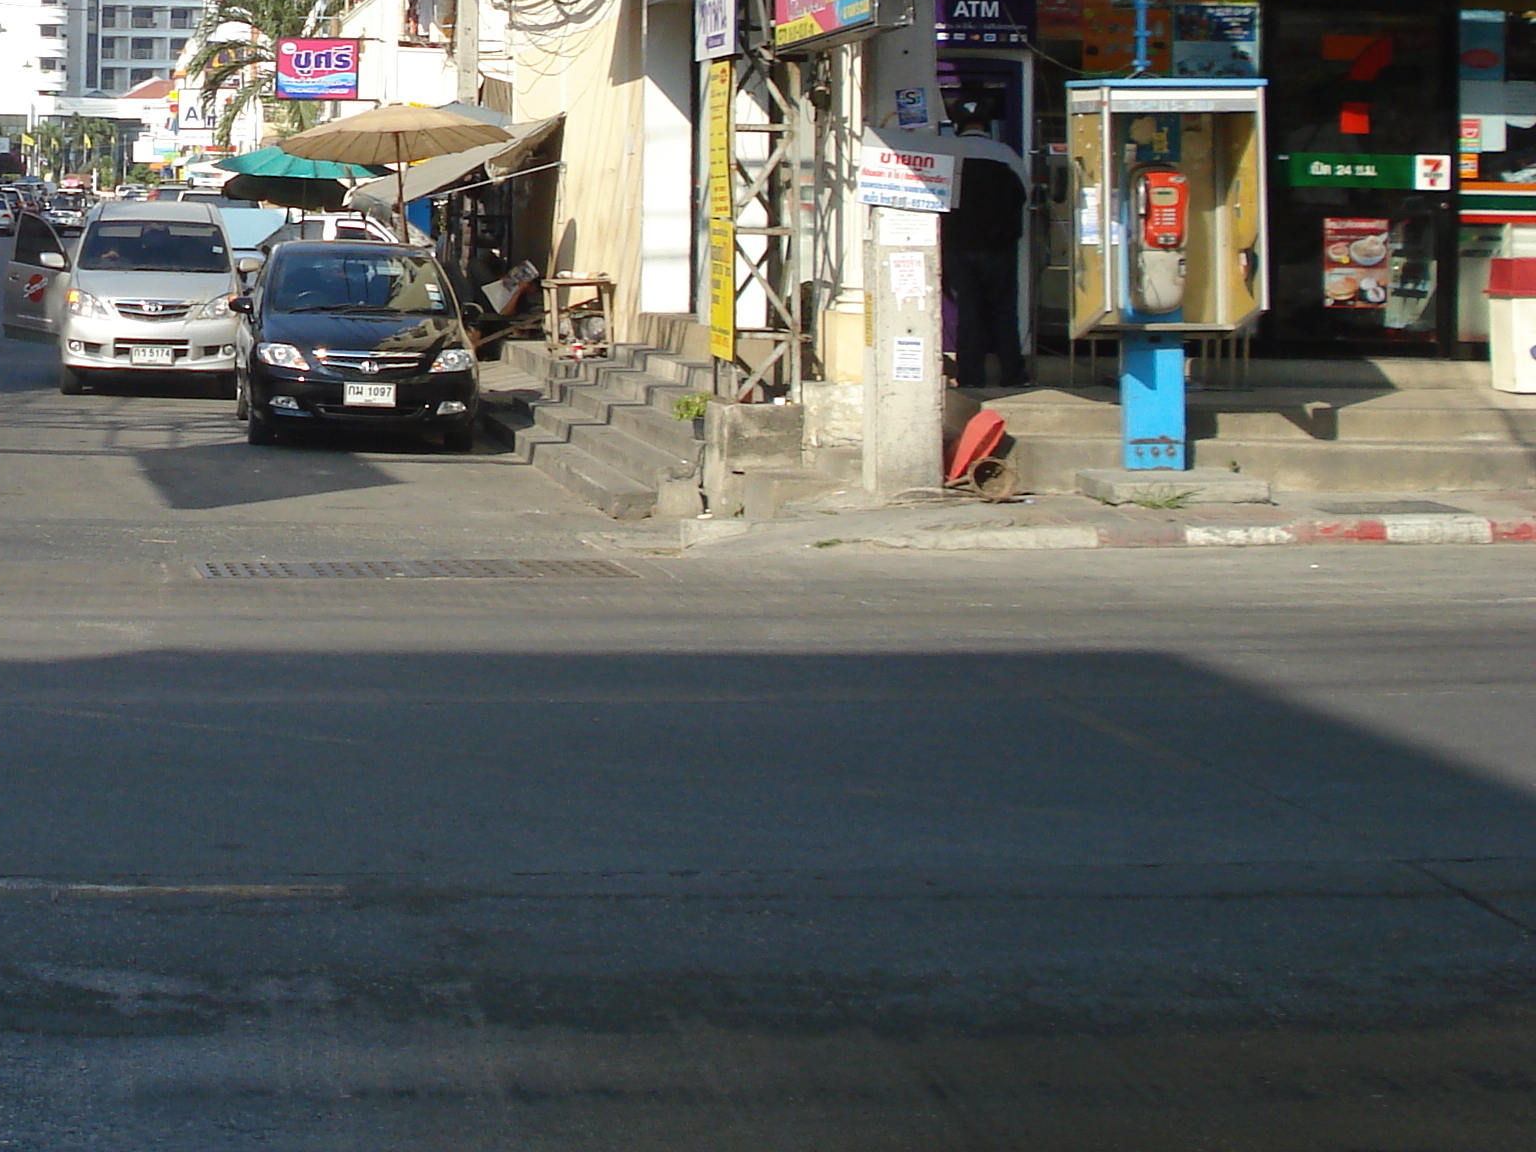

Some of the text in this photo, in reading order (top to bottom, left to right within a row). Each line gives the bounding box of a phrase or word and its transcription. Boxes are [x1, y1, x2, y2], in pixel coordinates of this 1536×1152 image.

[953, 0, 1000, 18] ATM
[879, 152, 935, 172] ขายถูก
[1335, 165, 1352, 176] 24
[149, 348, 170, 358] 5174
[368, 386, 392, 398] 1097
